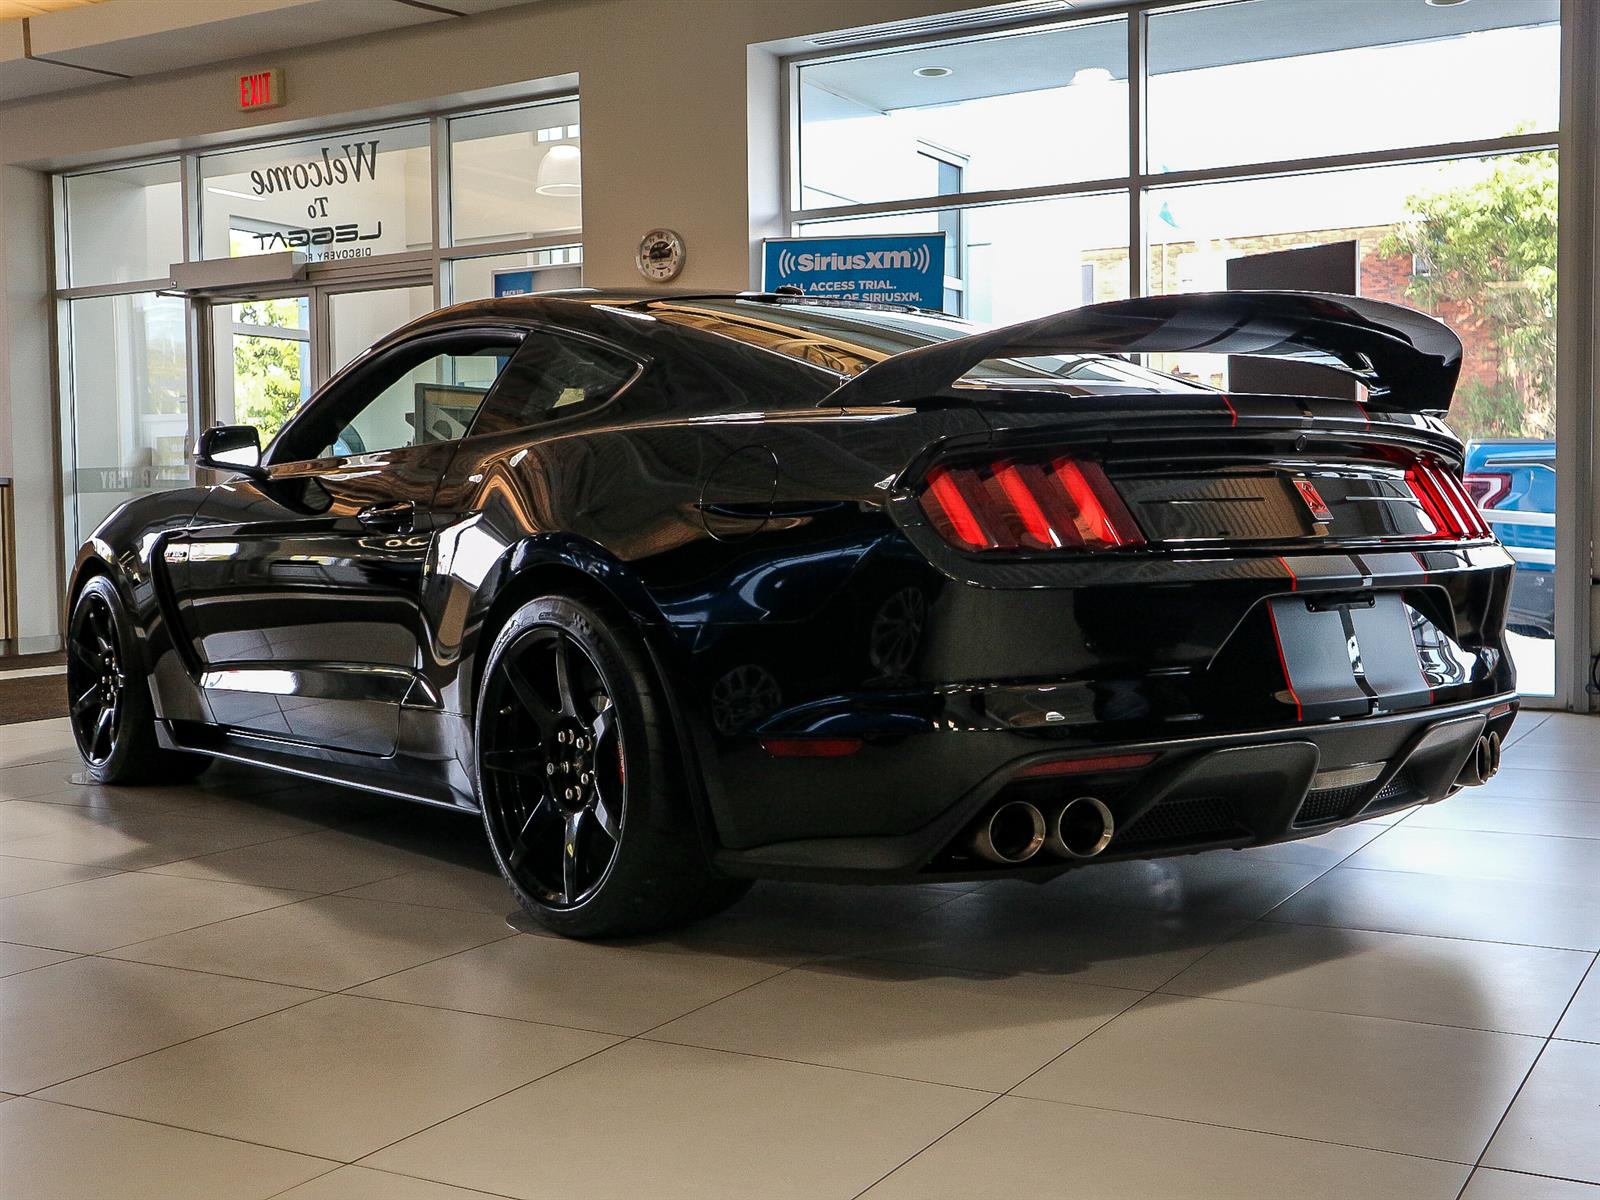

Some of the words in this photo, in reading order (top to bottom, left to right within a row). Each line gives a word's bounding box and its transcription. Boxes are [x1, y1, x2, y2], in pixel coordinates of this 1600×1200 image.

[240, 72, 271, 107] EXIT
[809, 281, 856, 291] ACCESS
[858, 280, 897, 290] TRIAL.
[862, 291, 923, 302] SIRIUSXM.
